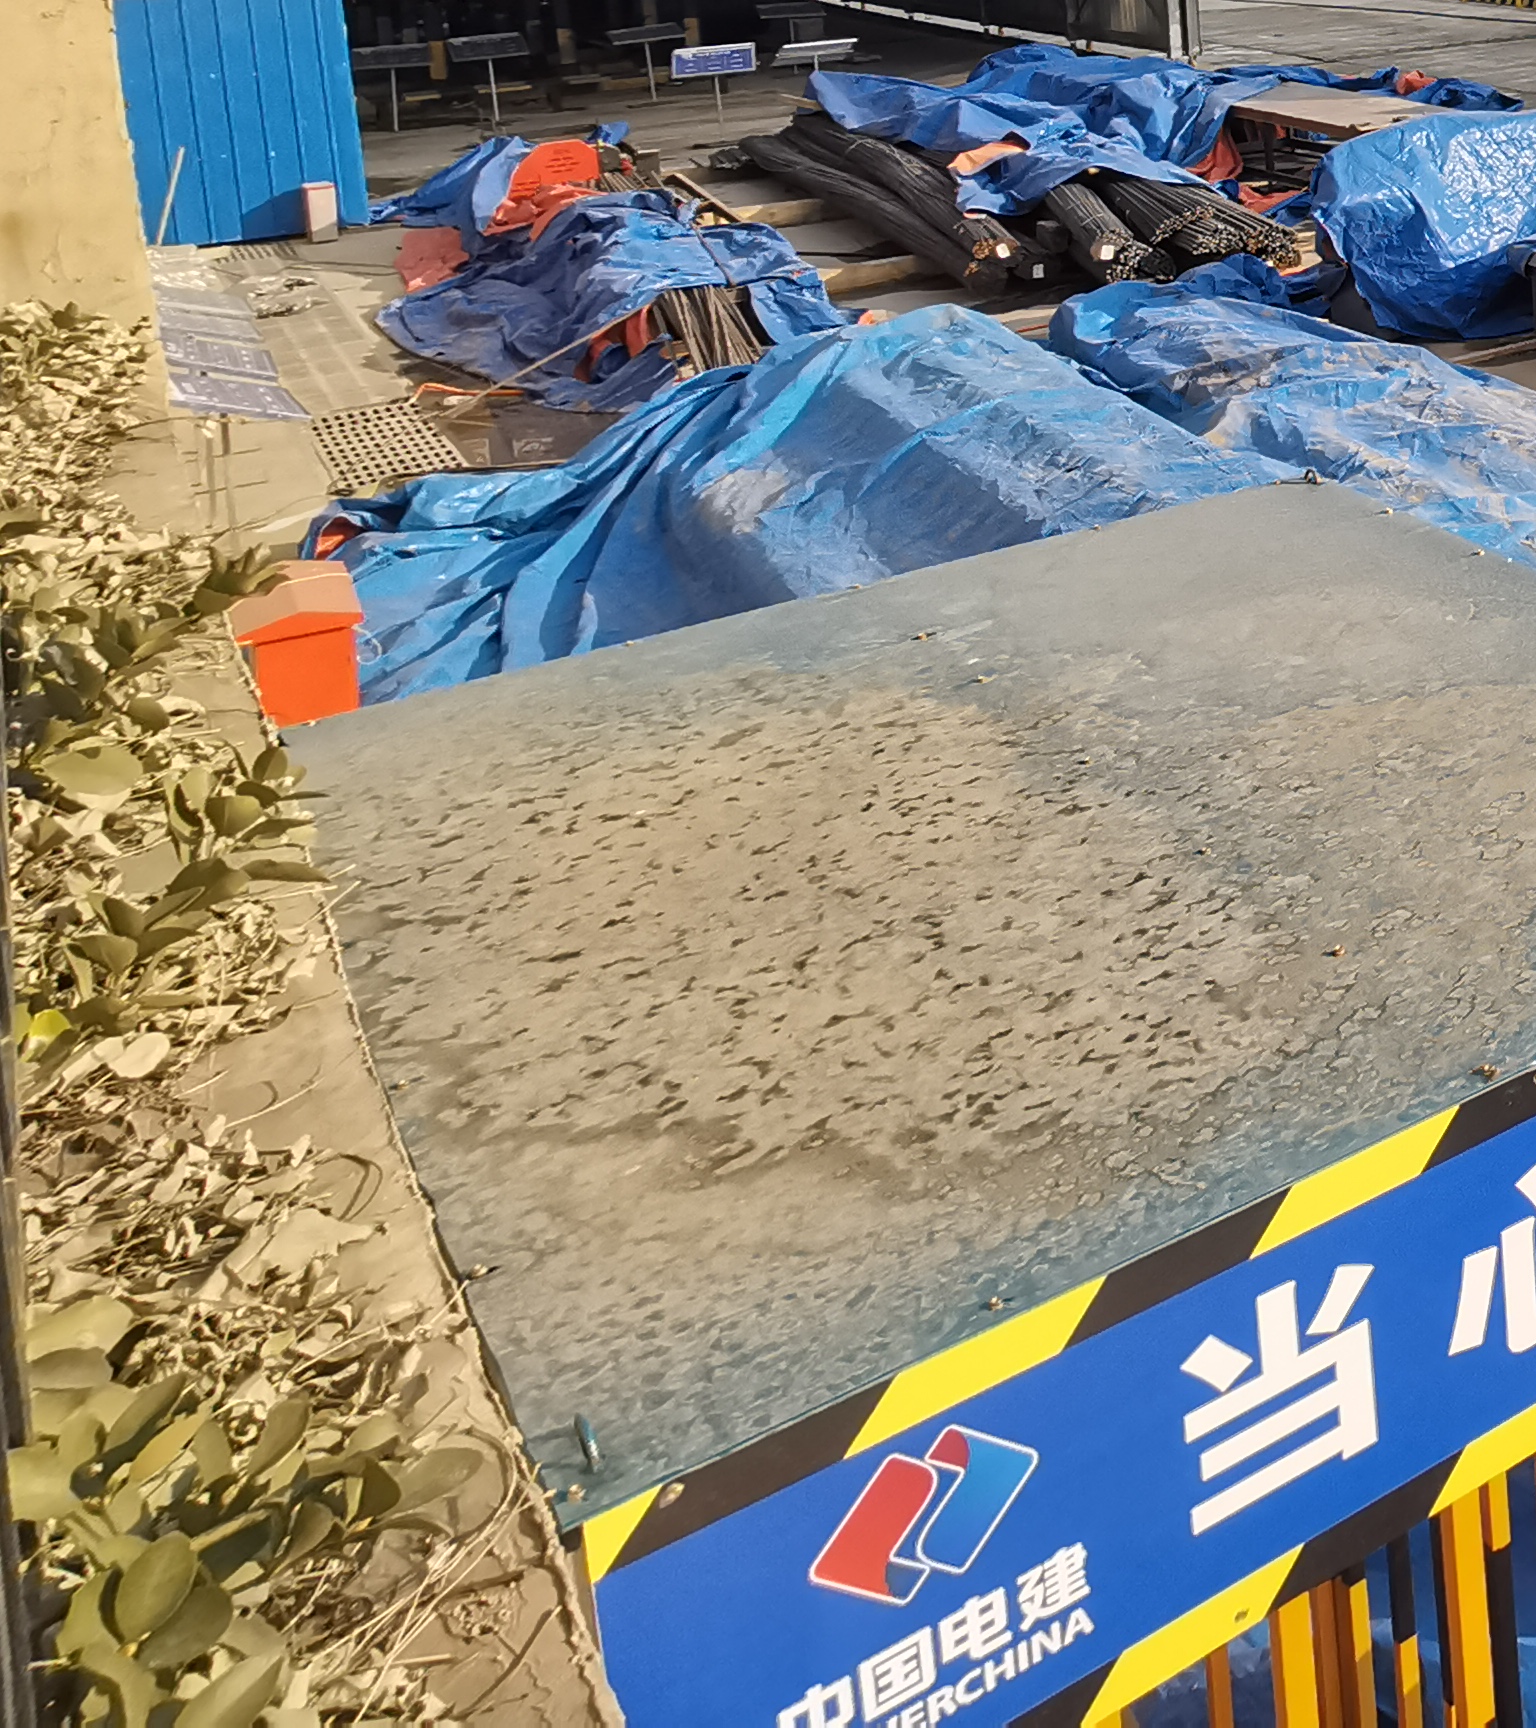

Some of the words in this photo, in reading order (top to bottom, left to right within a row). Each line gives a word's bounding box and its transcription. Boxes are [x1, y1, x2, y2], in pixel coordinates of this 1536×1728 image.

[776, 1542, 1093, 1728] 中国电建
[886, 1606, 1095, 1728] ERCHINA
